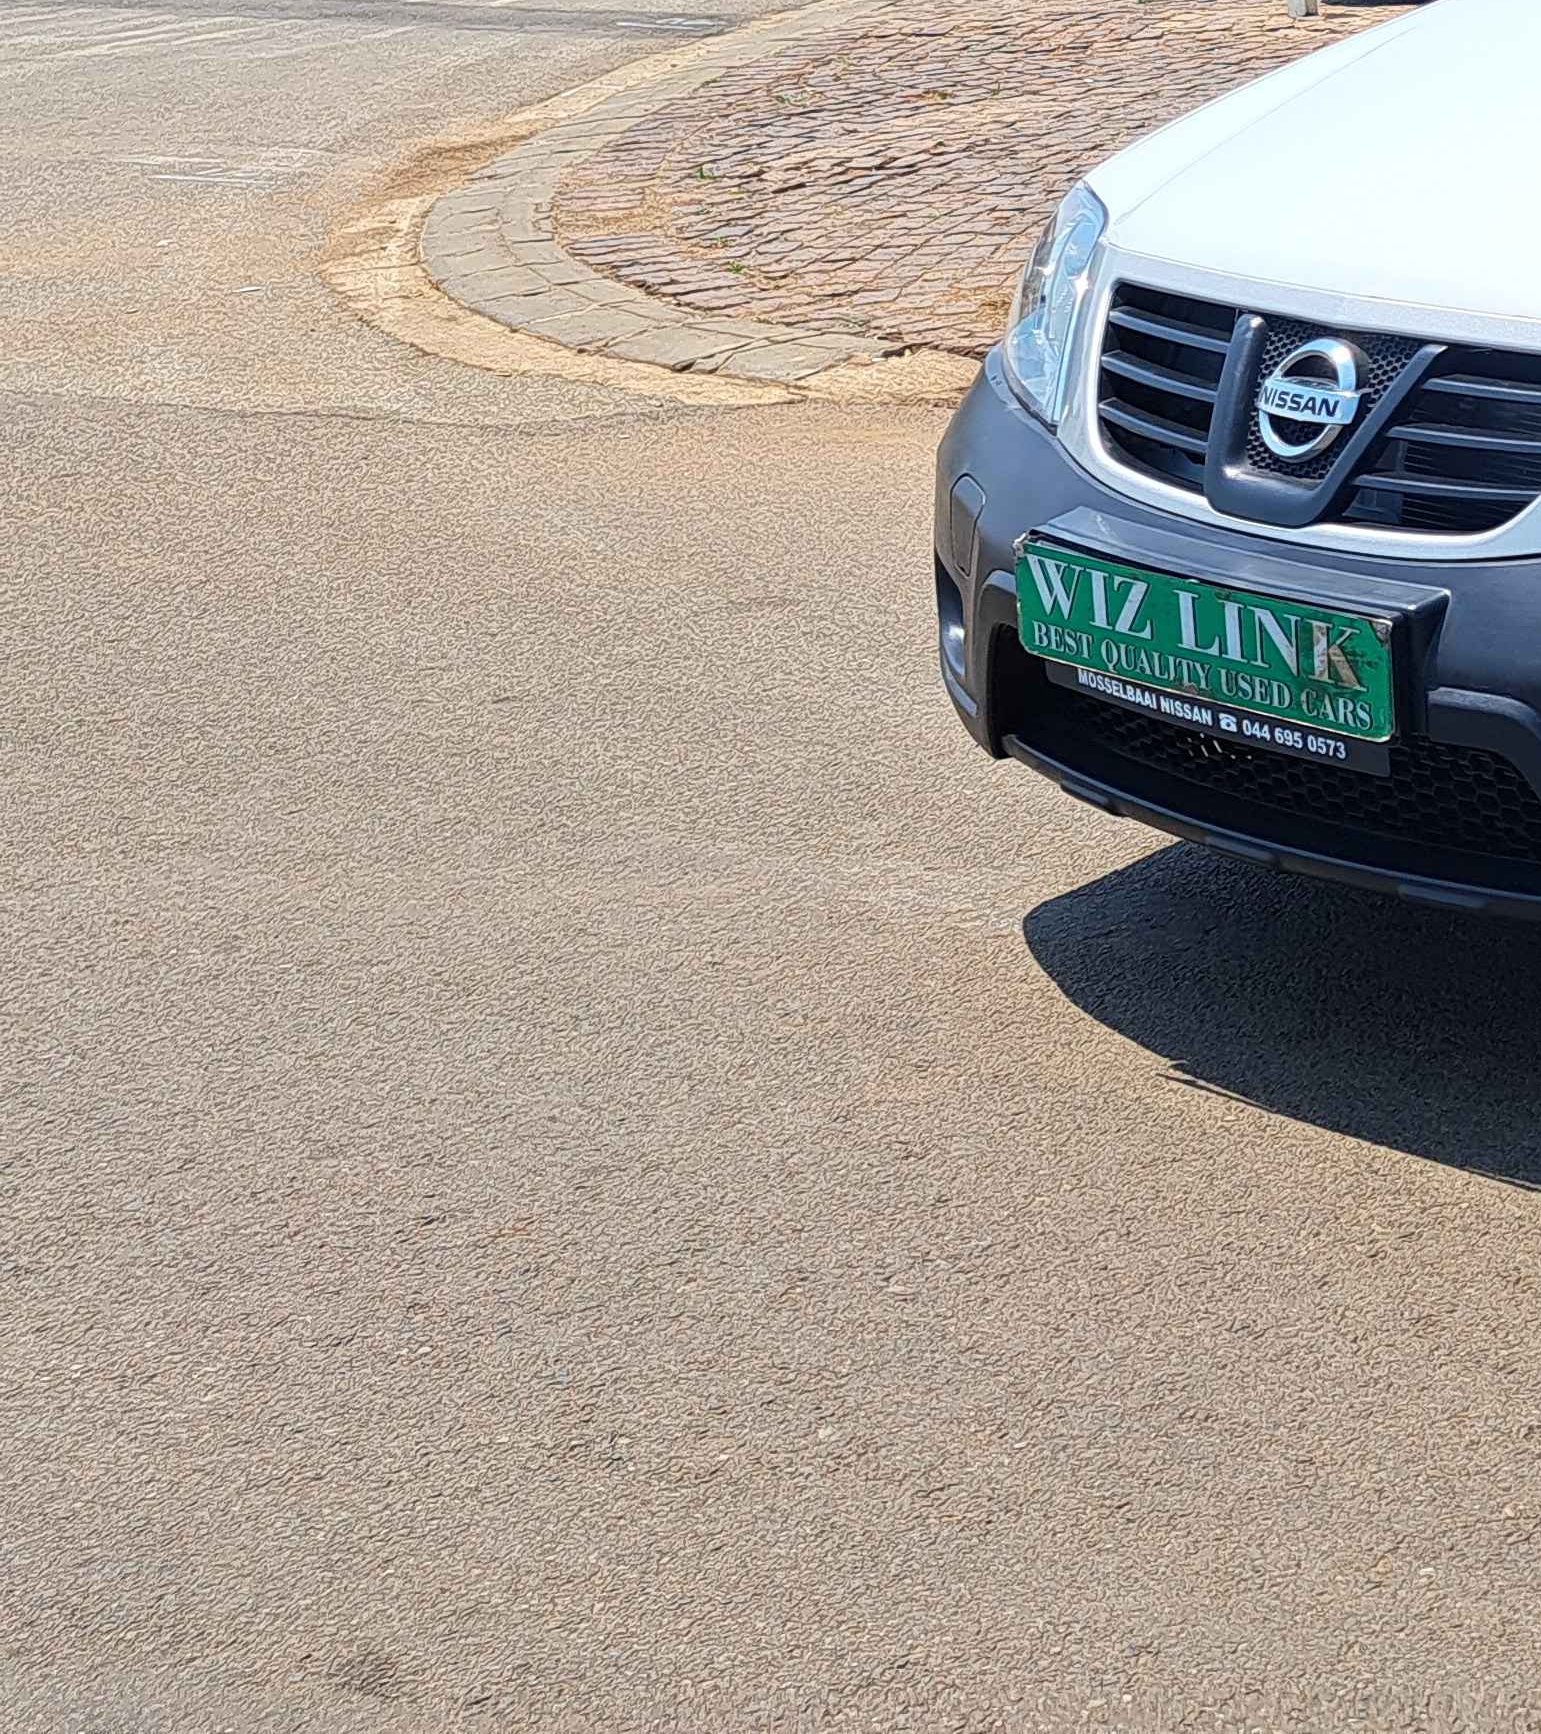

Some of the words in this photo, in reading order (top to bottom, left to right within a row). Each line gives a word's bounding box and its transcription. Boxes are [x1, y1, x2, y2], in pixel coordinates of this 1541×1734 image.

[1260, 386, 1340, 417] NISSAN
[1025, 553, 1152, 640] WIZ
[1173, 589, 1367, 692] LINK
[1033, 621, 1093, 660] BEST
[1101, 640, 1212, 691] QUALITY
[1218, 667, 1292, 709] USED
[1302, 688, 1373, 731] CARS
[1077, 668, 1157, 710] MOSSELBAAI
[1160, 696, 1213, 727] NISSAN
[1242, 718, 1271, 742] 044
[1274, 727, 1304, 749] 695
[1307, 735, 1347, 760] 0573
